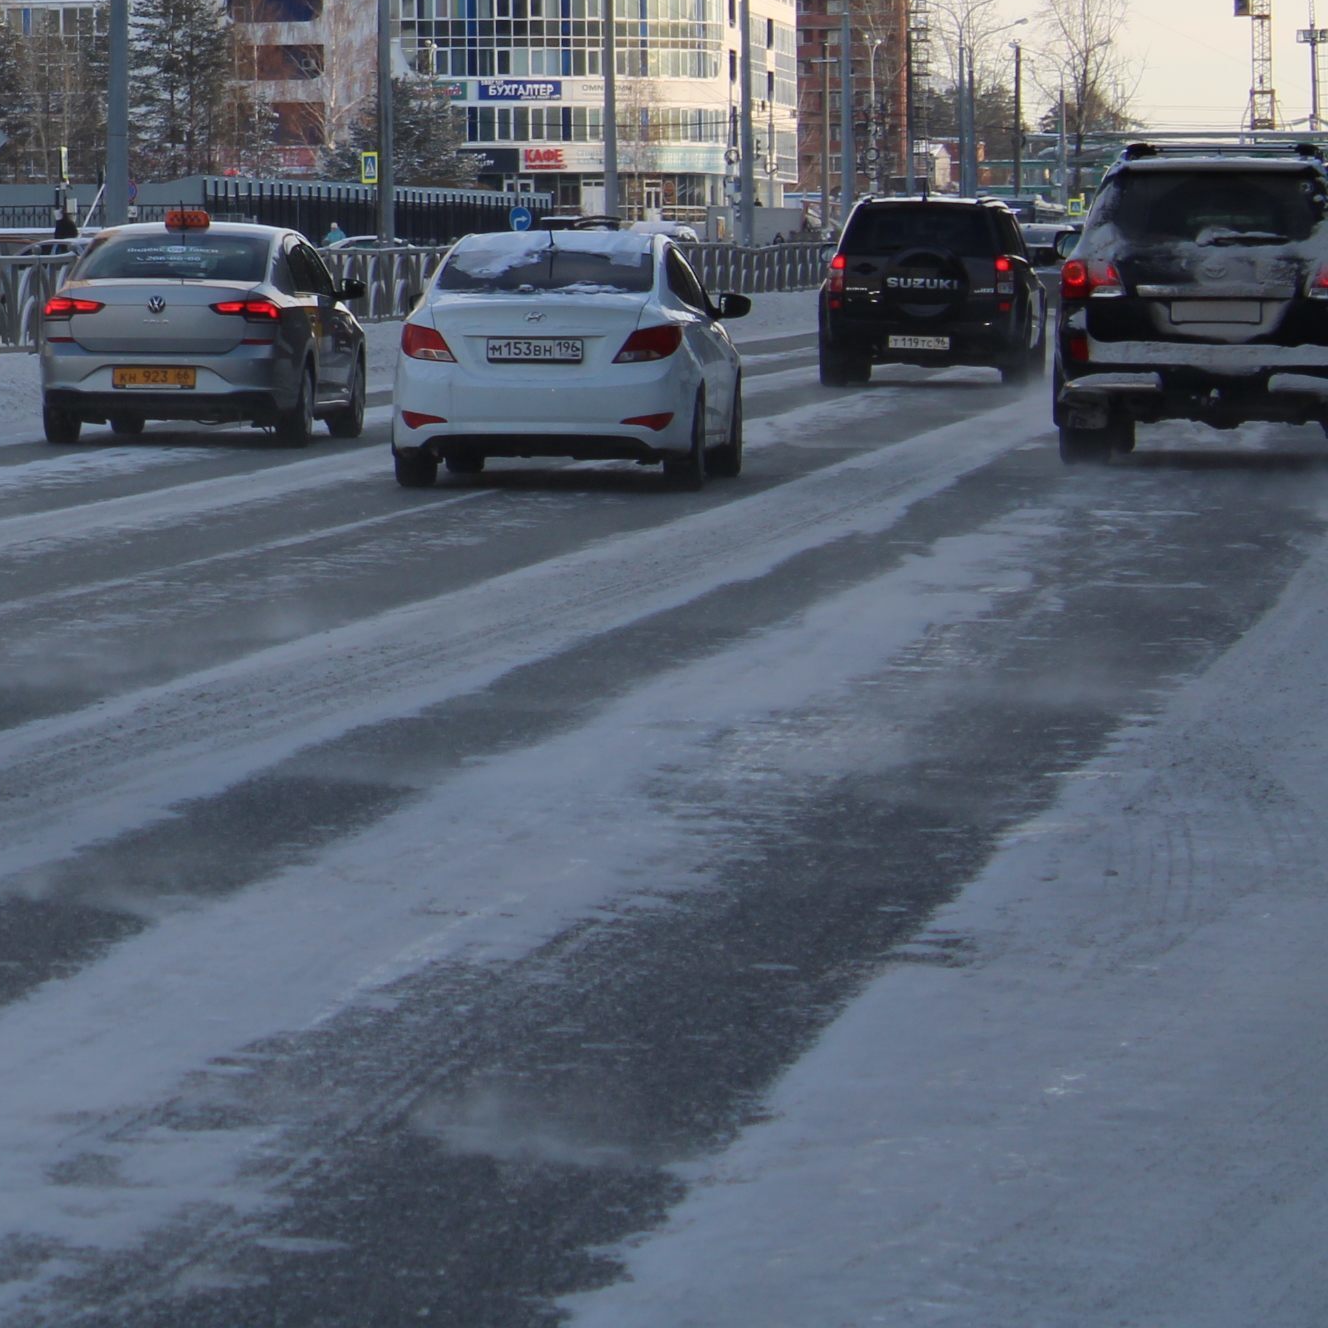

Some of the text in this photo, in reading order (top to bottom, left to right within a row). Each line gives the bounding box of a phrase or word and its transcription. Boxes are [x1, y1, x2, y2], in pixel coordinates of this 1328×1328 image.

[488, 84, 554, 96] БУХГАЛТЕР
[525, 149, 564, 162] КАФЕ
[886, 277, 958, 290] SUZUKI
[143, 371, 169, 383] 923
